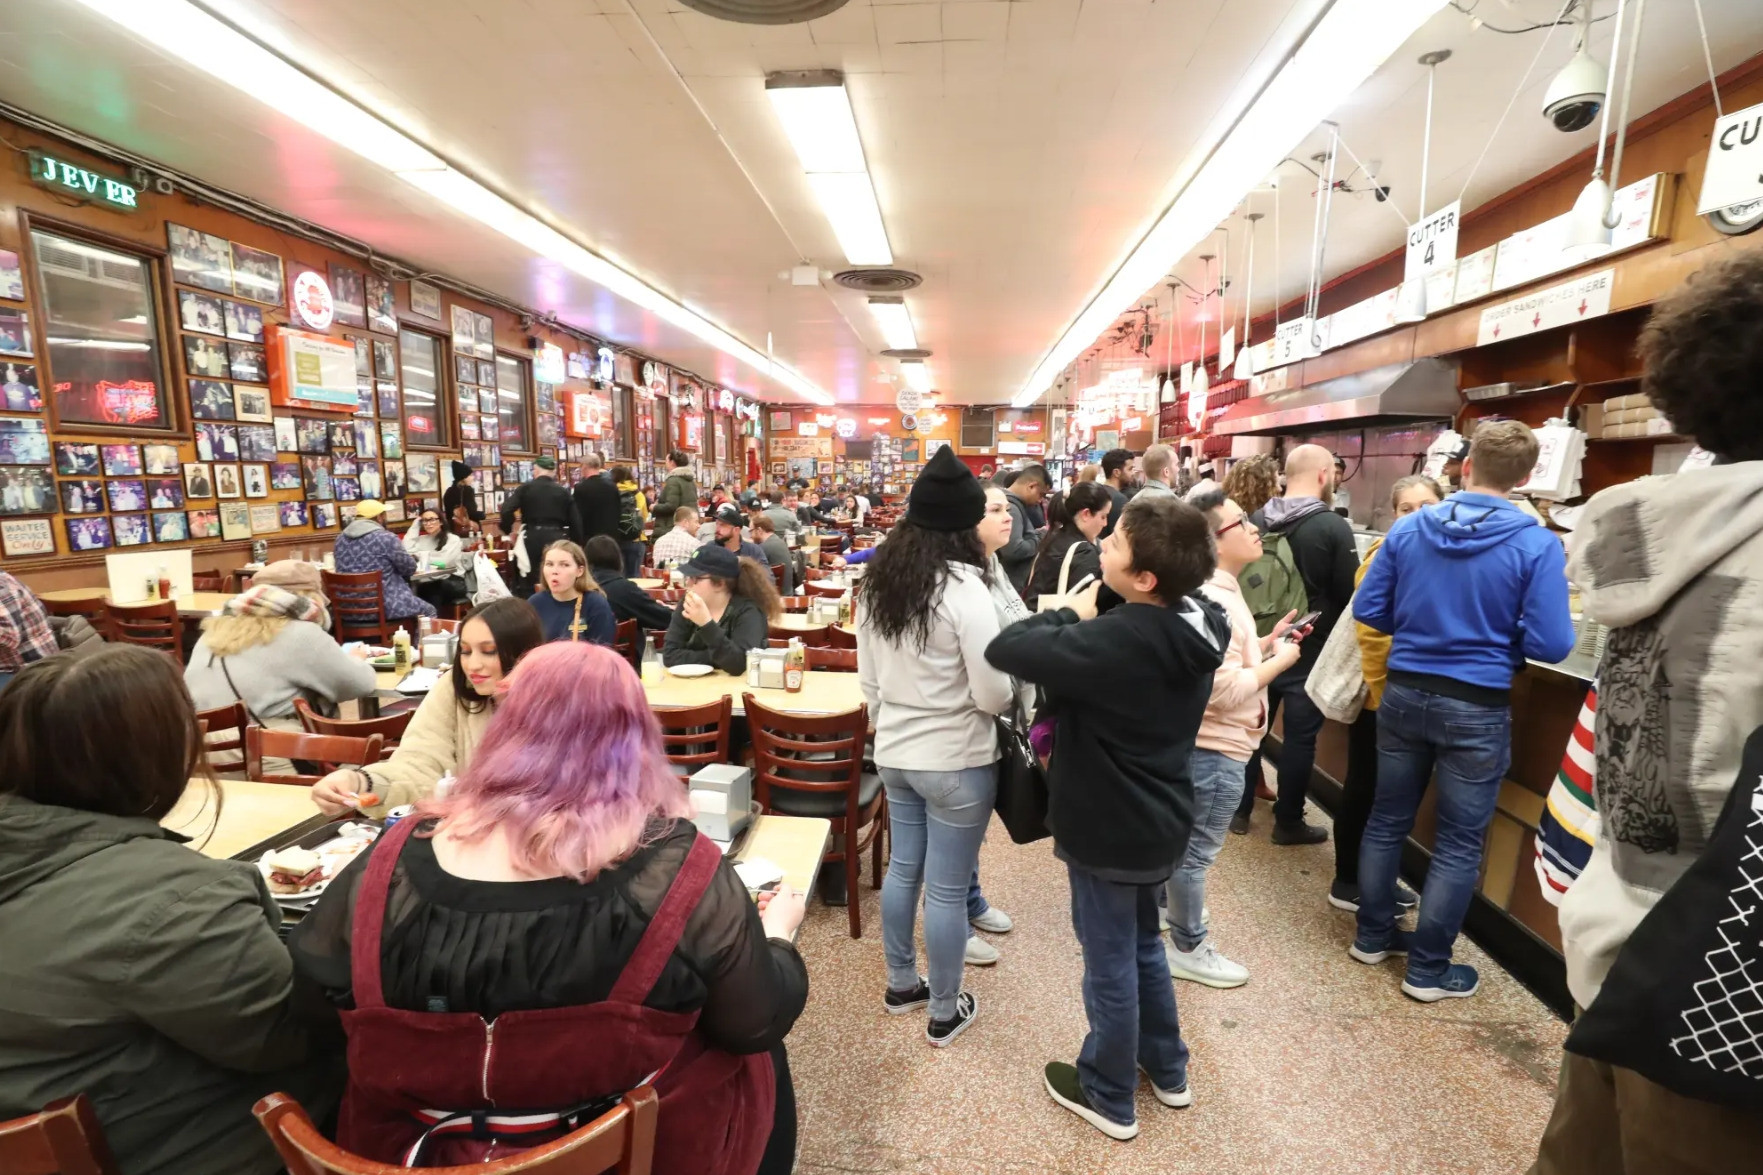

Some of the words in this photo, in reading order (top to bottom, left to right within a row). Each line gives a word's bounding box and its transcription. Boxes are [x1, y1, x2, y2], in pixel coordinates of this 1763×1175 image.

[43, 157, 137, 208] JEVER
[1410, 212, 1454, 247] CUTTER
[1424, 240, 1434, 265] 4
[1578, 277, 1607, 293] HERE
[1277, 323, 1303, 341] CUTTER
[1285, 340, 1291, 358] 5
